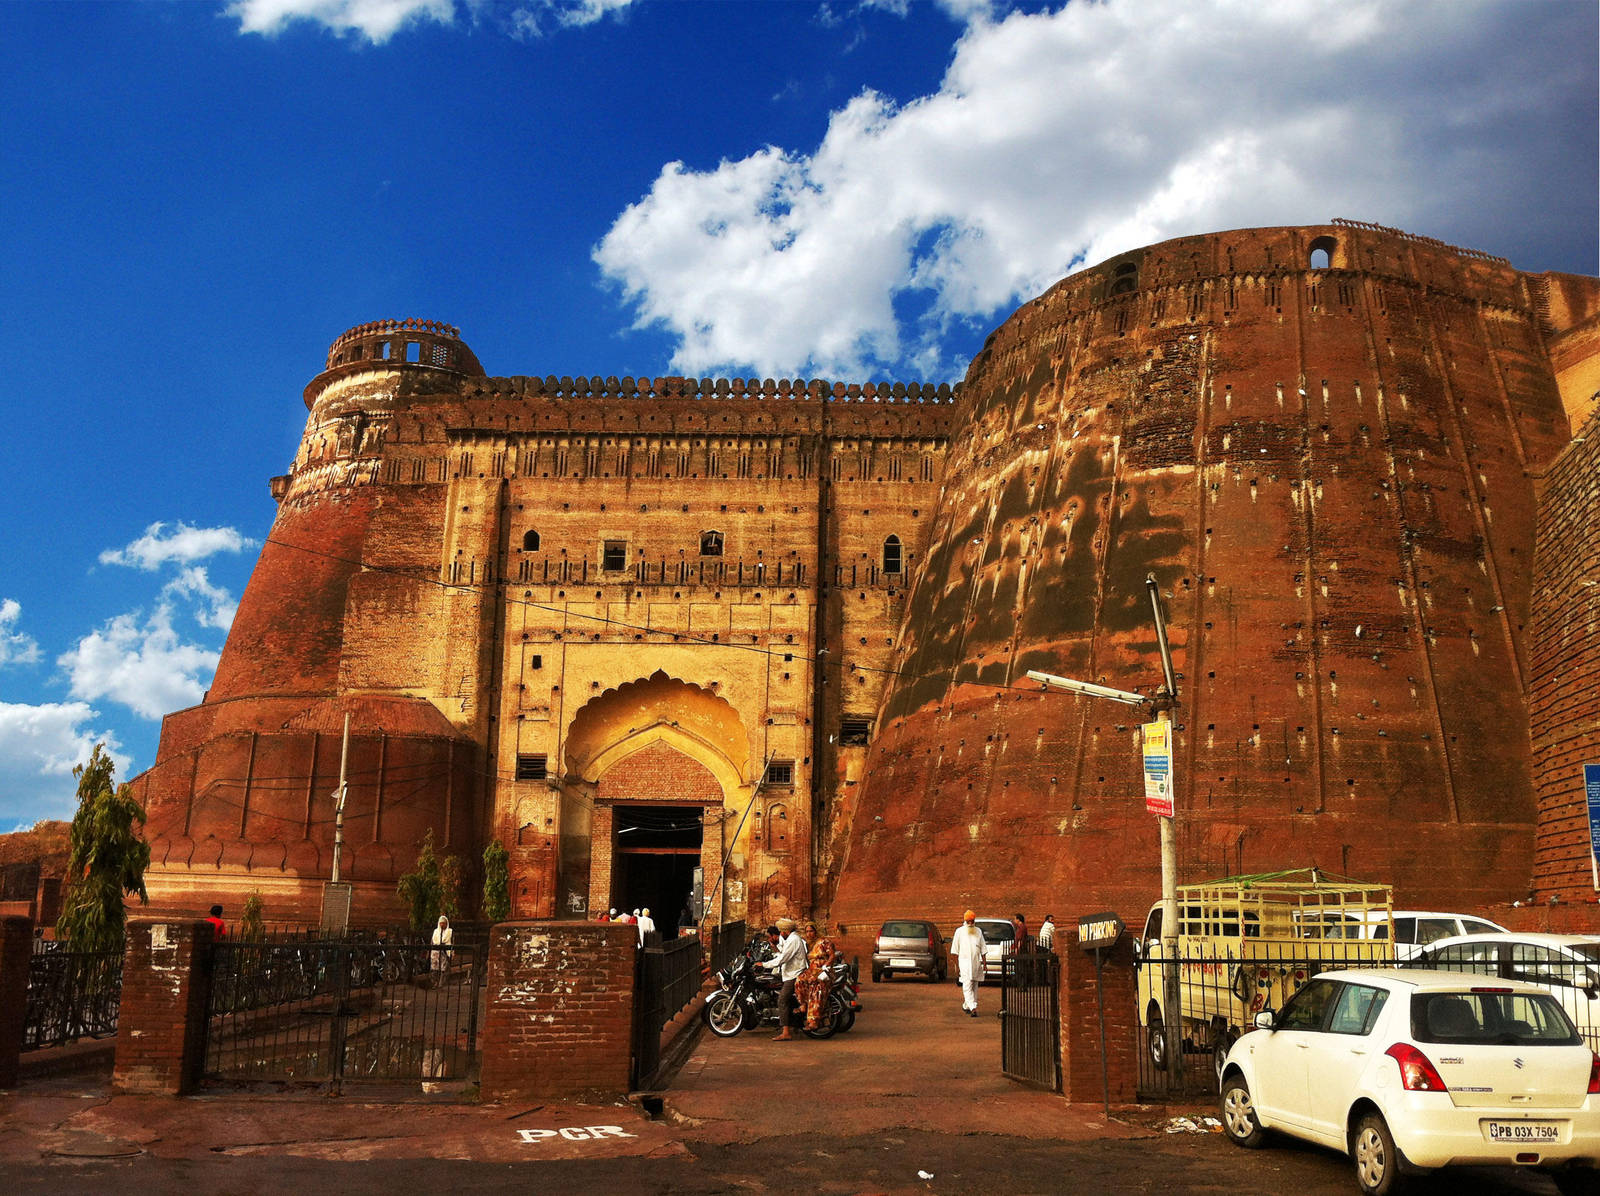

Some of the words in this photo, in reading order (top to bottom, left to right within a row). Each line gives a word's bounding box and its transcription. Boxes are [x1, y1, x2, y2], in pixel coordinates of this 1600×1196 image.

[1078, 923, 1088, 942] NO
[1089, 920, 1117, 940] PARKING
[516, 1125, 639, 1143] PCR
[1498, 1126, 1512, 1137] PB
[1514, 1126, 1533, 1137] 03X
[1535, 1126, 1558, 1137] 7504
